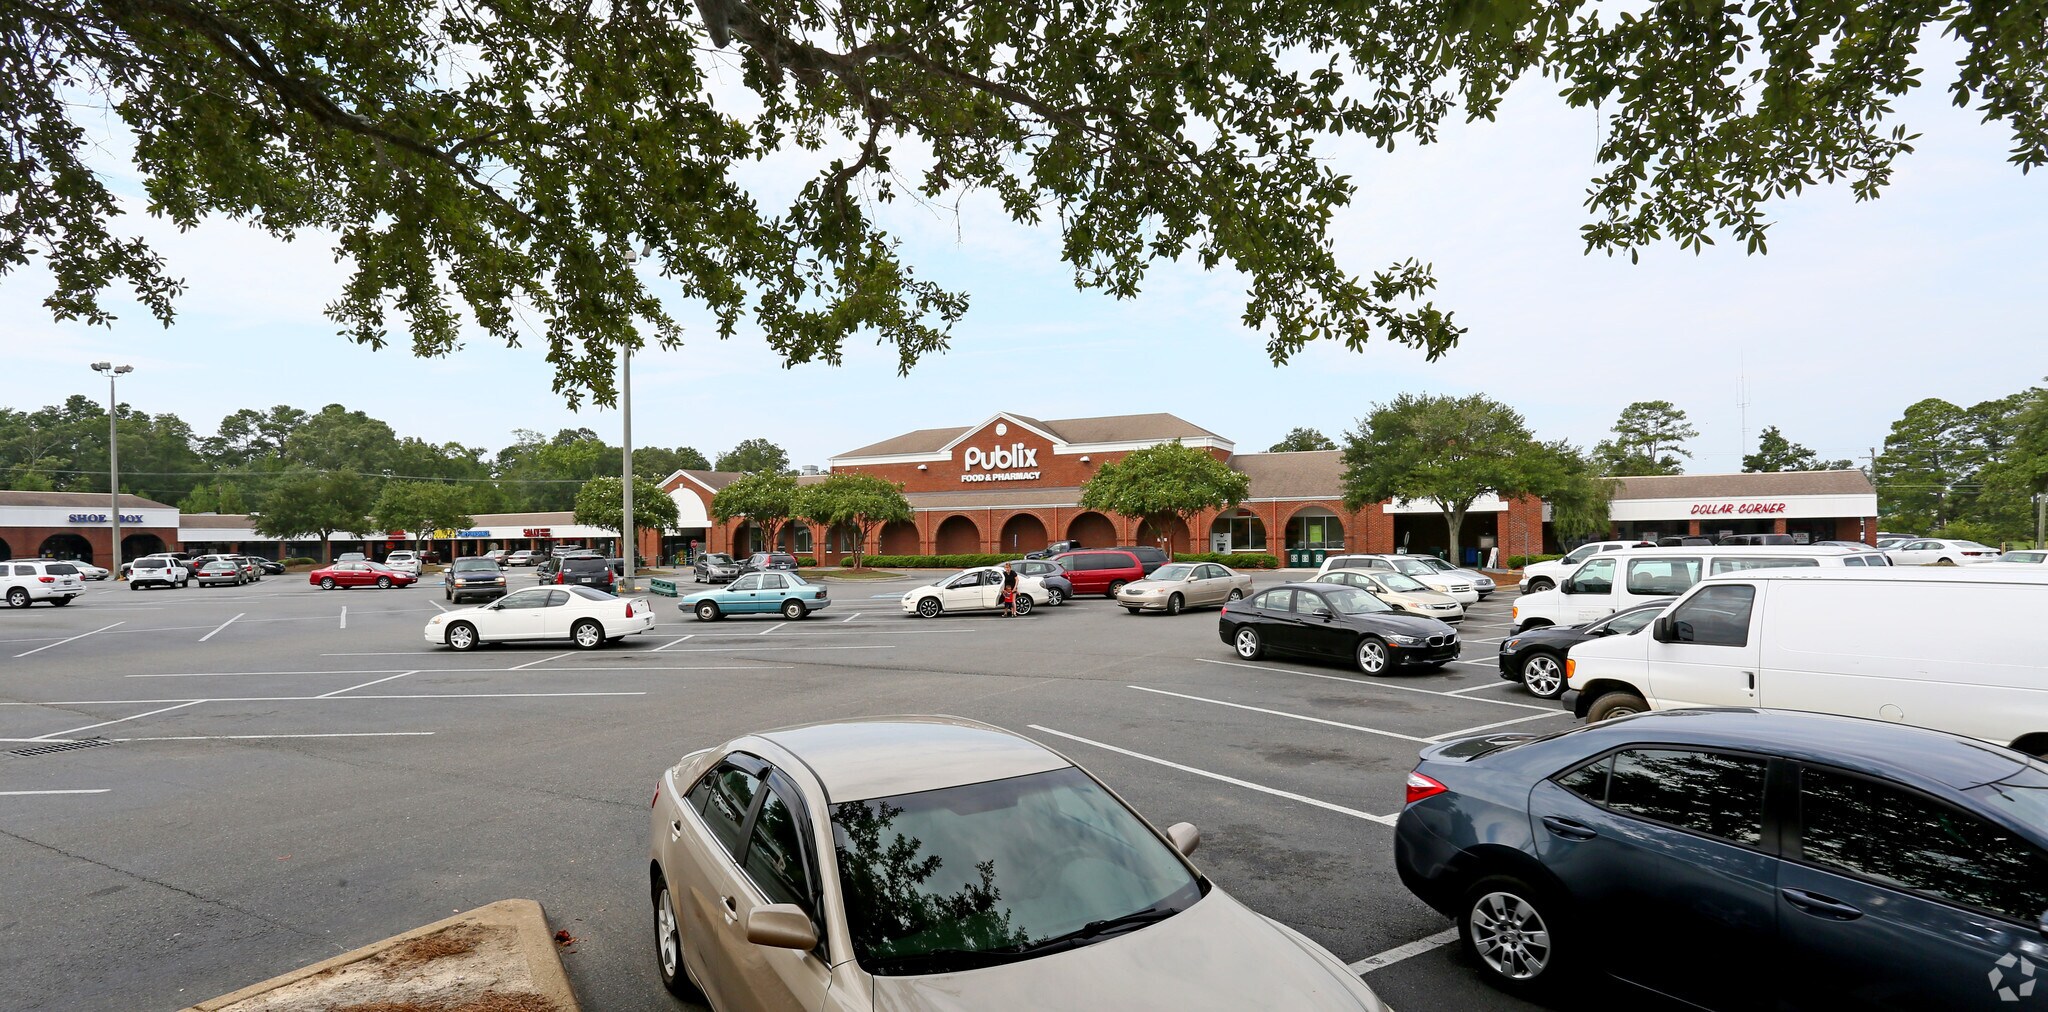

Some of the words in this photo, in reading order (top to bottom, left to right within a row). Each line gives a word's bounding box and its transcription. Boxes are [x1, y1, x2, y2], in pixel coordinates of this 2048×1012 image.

[964, 442, 1038, 472] Publix
[961, 474, 984, 482] FOOD
[985, 473, 992, 481] &
[992, 471, 1041, 480] PHARMACY
[1690, 504, 1734, 515] DOLLAR
[1738, 503, 1786, 514] CORNER
[68, 513, 107, 523] SHOE
[118, 514, 144, 523] BOX
